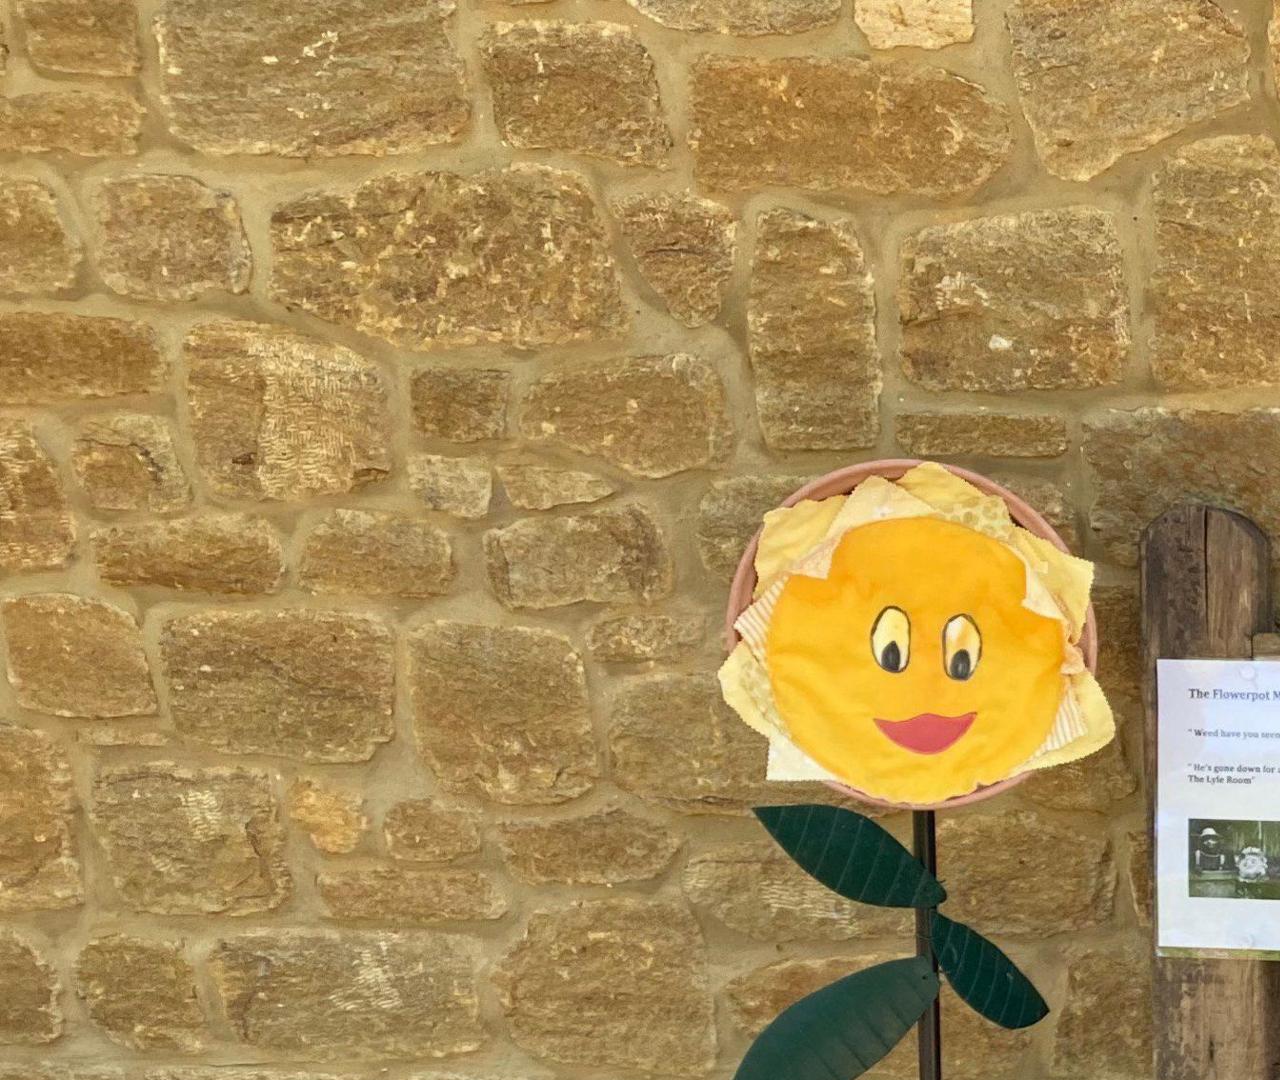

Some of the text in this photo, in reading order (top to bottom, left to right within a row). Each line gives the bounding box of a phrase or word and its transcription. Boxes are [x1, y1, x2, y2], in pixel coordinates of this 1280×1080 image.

[1188, 688, 1209, 699] The
[1213, 689, 1270, 702] Flowerpot
[1243, 731, 1259, 740] you
